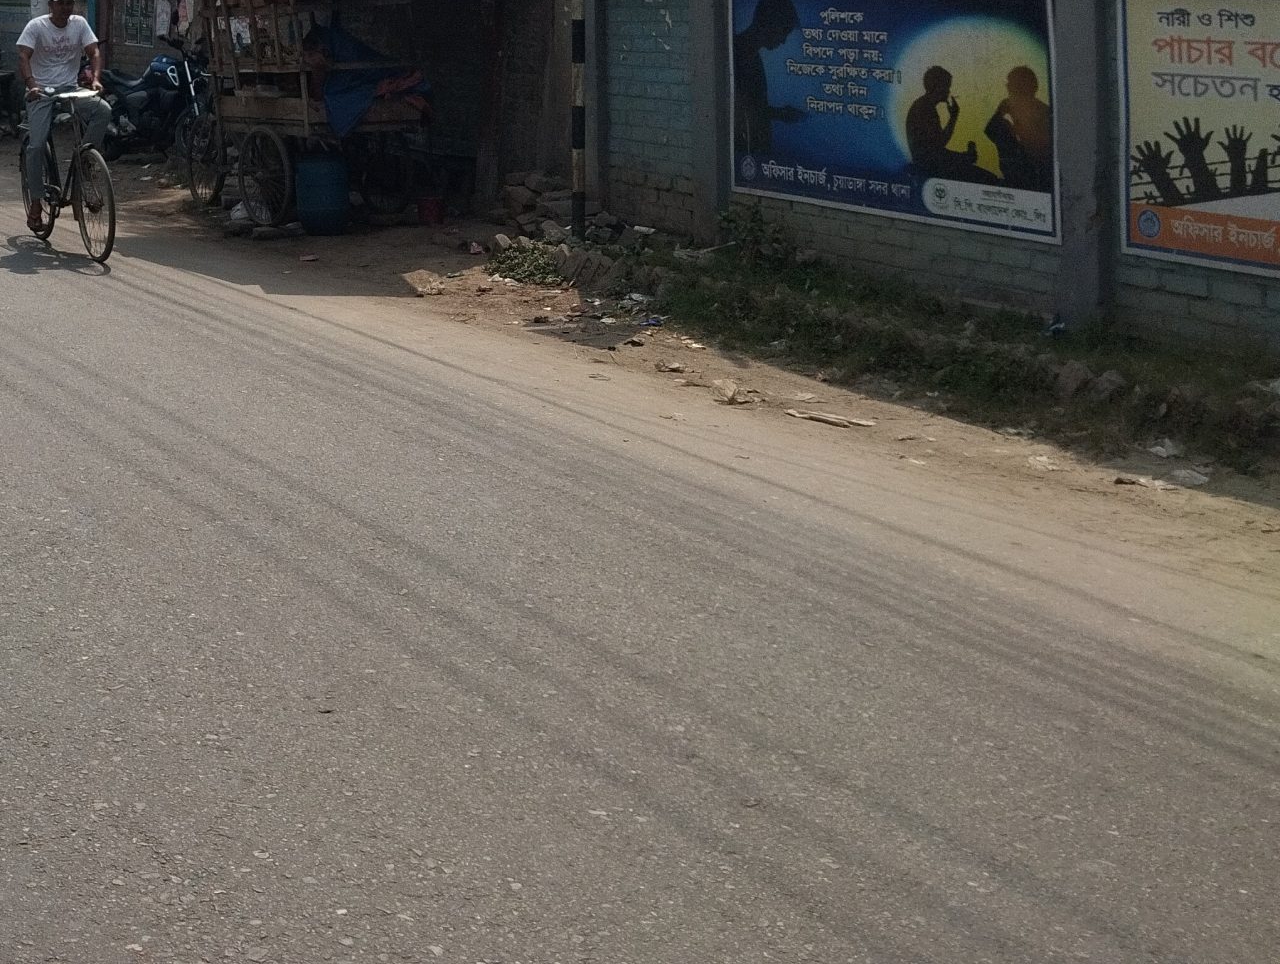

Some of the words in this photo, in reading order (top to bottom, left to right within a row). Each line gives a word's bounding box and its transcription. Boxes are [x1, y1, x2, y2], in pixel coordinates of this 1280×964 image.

[820, 7, 864, 25] পুলিশকে
[1158, 9, 1190, 29] নারী
[1197, 13, 1212, 28] ও
[1218, 8, 1256, 29] শিশু
[802, 28, 823, 43] তথ্য
[826, 29, 859, 44] দেওয়া
[863, 30, 889, 44] মানে
[802, 43, 833, 59] বিপদে
[837, 47, 860, 63] পড়া
[1152, 35, 1234, 68] পাচার
[786, 59, 826, 76] নিজেকে
[828, 63, 868, 81] সুরক্ষিত
[822, 83, 844, 97] তথ্য
[847, 82, 868, 97] দিন
[1151, 71, 1262, 103] সচেতন
[806, 96, 845, 114] নিরাপদ
[761, 162, 794, 181] অফিসার
[869, 179, 889, 194] সদর
[891, 181, 911, 199] থানা
[1170, 215, 1225, 244] অফিসার
